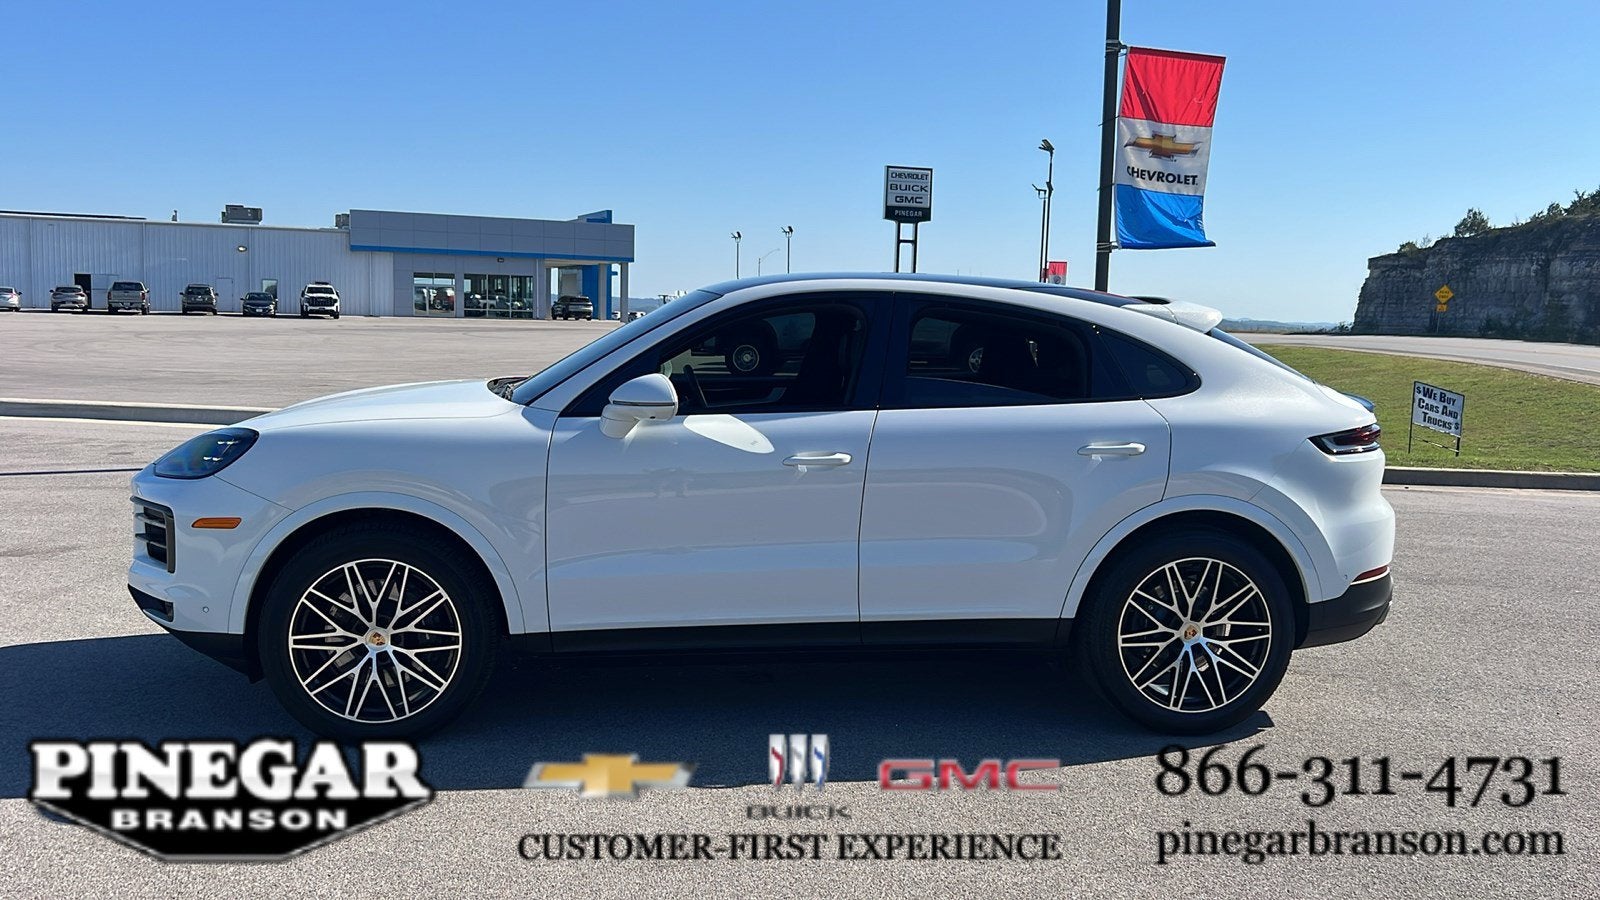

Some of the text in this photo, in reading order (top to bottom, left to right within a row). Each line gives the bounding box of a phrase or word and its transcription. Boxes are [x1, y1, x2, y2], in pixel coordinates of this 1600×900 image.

[890, 172, 929, 180] CHEVROLET
[890, 183, 928, 192] BUICK
[895, 195, 923, 204] GMC
[894, 209, 923, 217] PINEGAR
